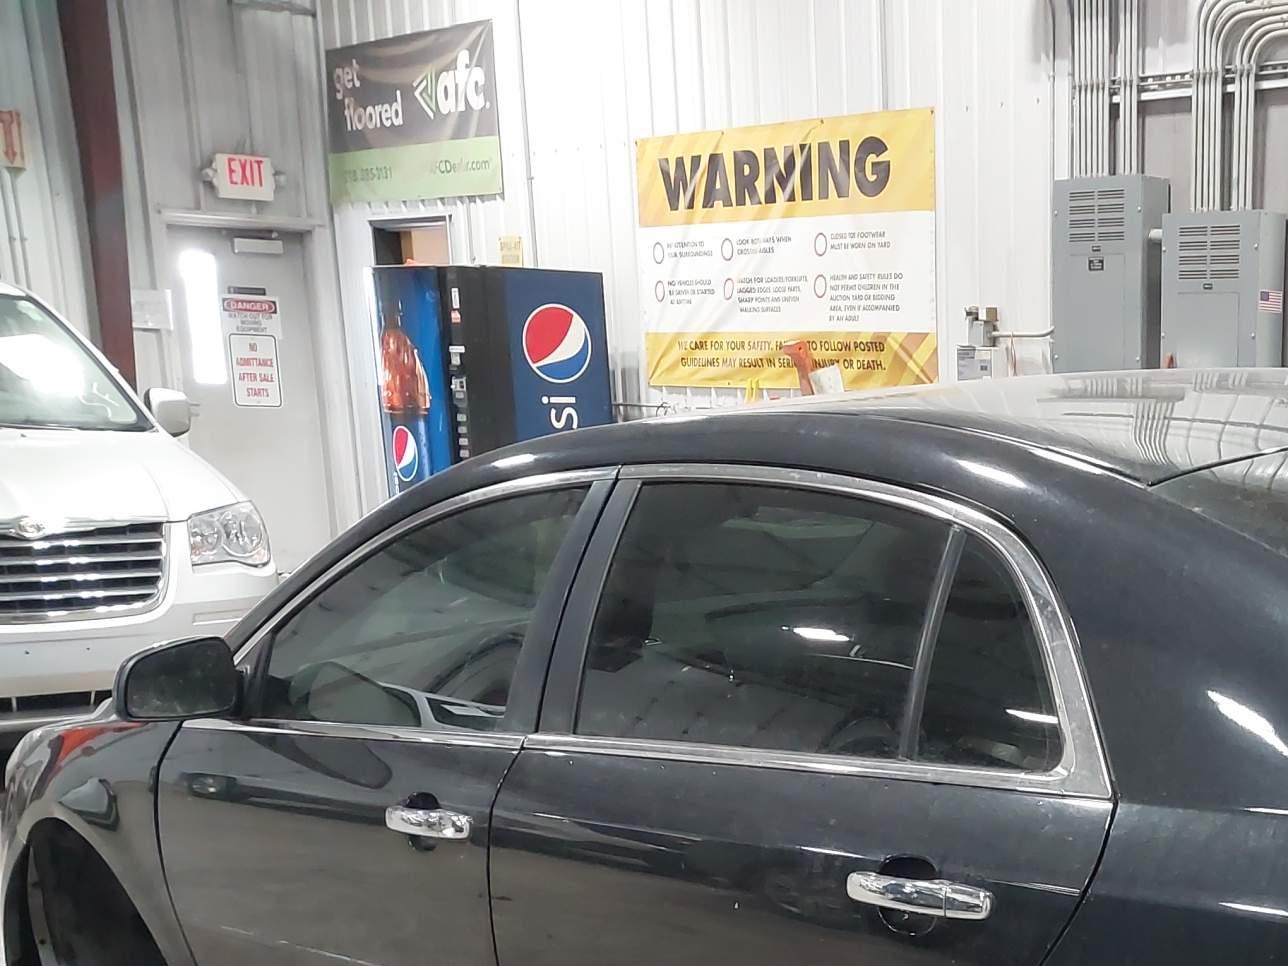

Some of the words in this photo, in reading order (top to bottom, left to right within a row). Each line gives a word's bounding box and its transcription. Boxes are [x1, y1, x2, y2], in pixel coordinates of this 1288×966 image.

[333, 59, 361, 100] get
[344, 90, 403, 131] floored
[227, 157, 264, 187] EXIT
[658, 136, 891, 211] WARNING
[857, 231, 886, 239] FOOTWEAR
[830, 273, 847, 281] HEALTH
[230, 300, 269, 311] DANGER
[862, 304, 900, 312] ACCOMPANIED
[248, 342, 258, 352] NO
[689, 340, 709, 351] CARE
[710, 340, 724, 351] FOR
[726, 340, 746, 351] YOUR
[806, 340, 817, 351] TO
[819, 340, 852, 351] FOLLOW
[853, 341, 885, 352] POSTED
[236, 357, 274, 368] ADMITTANCE
[681, 357, 720, 368] GUIDELINES
[722, 357, 737, 368] MAY
[738, 357, 764, 368] RESULT
[767, 358, 776, 368] IN
[843, 360, 854, 370] OR
[856, 360, 886, 371] DEATH.
[239, 372, 257, 382] AFTER
[258, 373, 274, 383] SALE
[246, 387, 269, 398] STARTS
